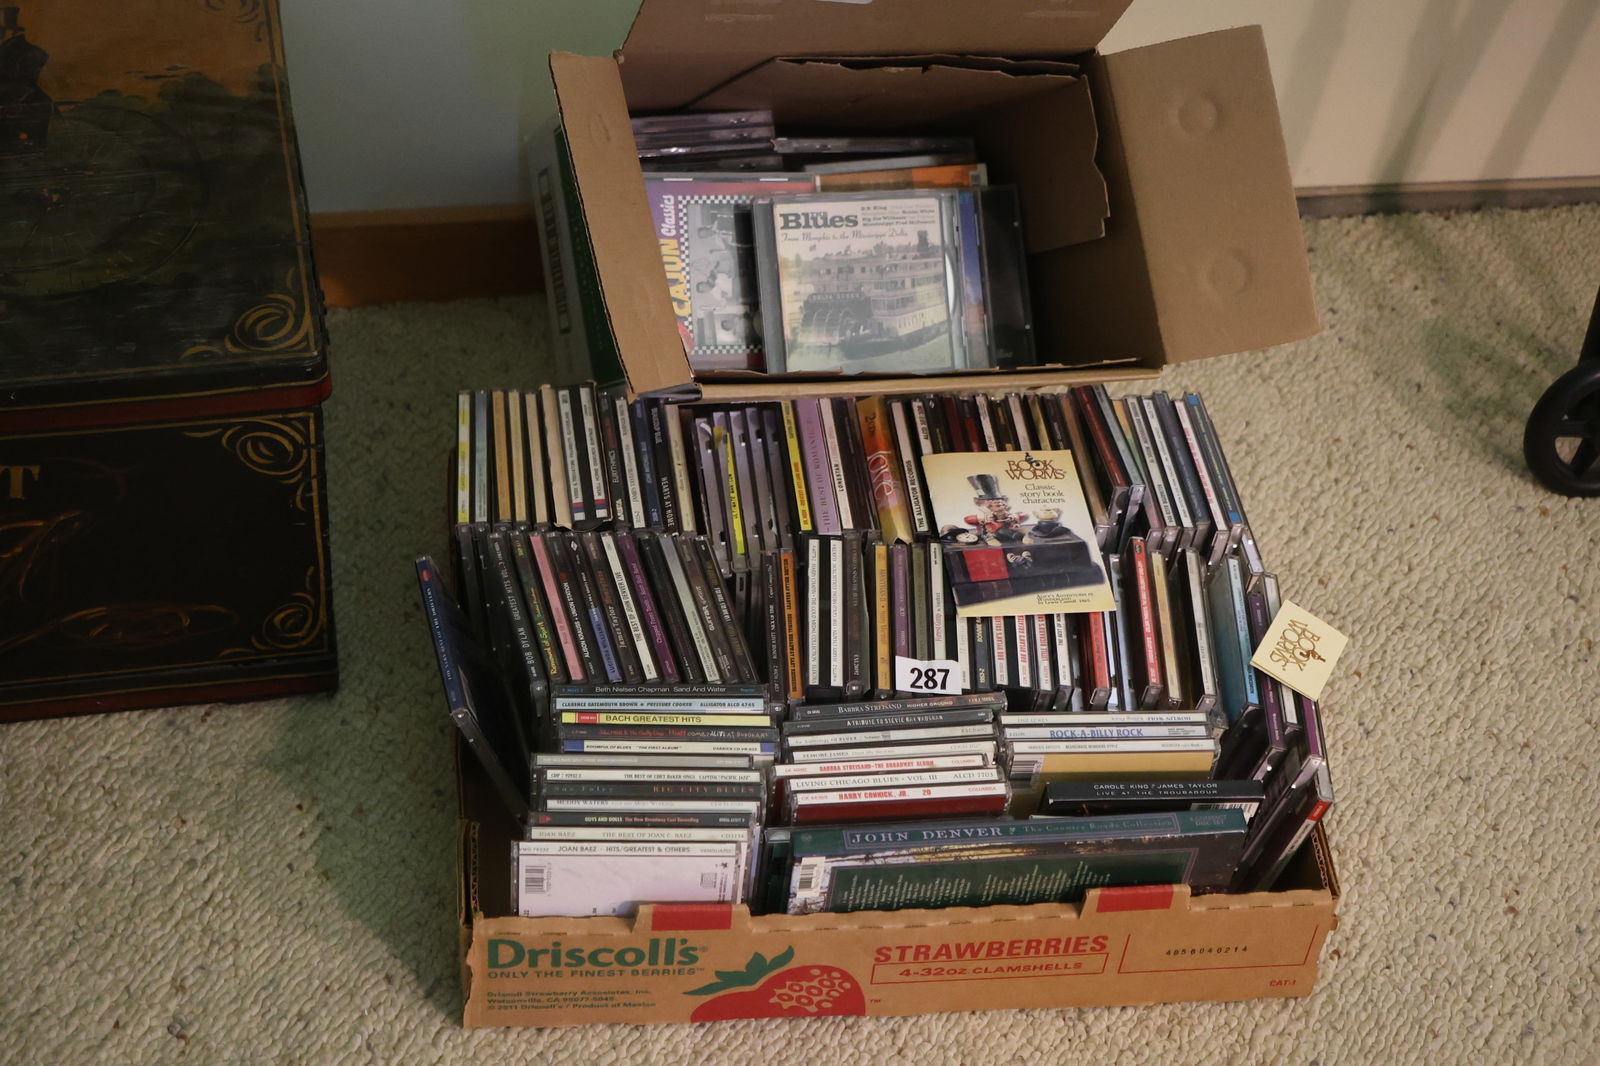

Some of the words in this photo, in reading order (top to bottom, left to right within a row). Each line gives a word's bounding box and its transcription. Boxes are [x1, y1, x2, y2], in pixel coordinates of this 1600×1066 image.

[660, 195, 676, 236] Classics
[780, 213, 858, 230] Blues
[659, 239, 691, 320] CAJUN
[905, 459, 916, 486] RECORDS
[1005, 469, 1065, 480] WORMS
[1008, 460, 1053, 472] BOOK
[833, 463, 844, 492] LONESTAR
[910, 486, 922, 516] ALLIGATOR
[916, 515, 925, 528] THE
[517, 626, 529, 648] DYLAN
[613, 626, 626, 649] James
[524, 650, 534, 664] BOB
[910, 668, 950, 690] 287
[865, 703, 902, 713] STREISAND
[681, 715, 702, 723] HITS
[1050, 729, 1114, 739] ROCK-A-BILLY
[1116, 728, 1143, 737] ROCK
[829, 778, 870, 786] CHICAGO
[839, 792, 862, 801] HARRY
[852, 832, 908, 844] JOHN
[923, 827, 1002, 840] DENVER
[487, 938, 700, 969] Driscoll's
[874, 936, 1109, 963] STRAWBERRIES
[488, 971, 528, 979] ONLY
[535, 970, 563, 978] THE
[631, 968, 696, 977] BERRIES
[972, 962, 1082, 975] CLAMSHELLS
